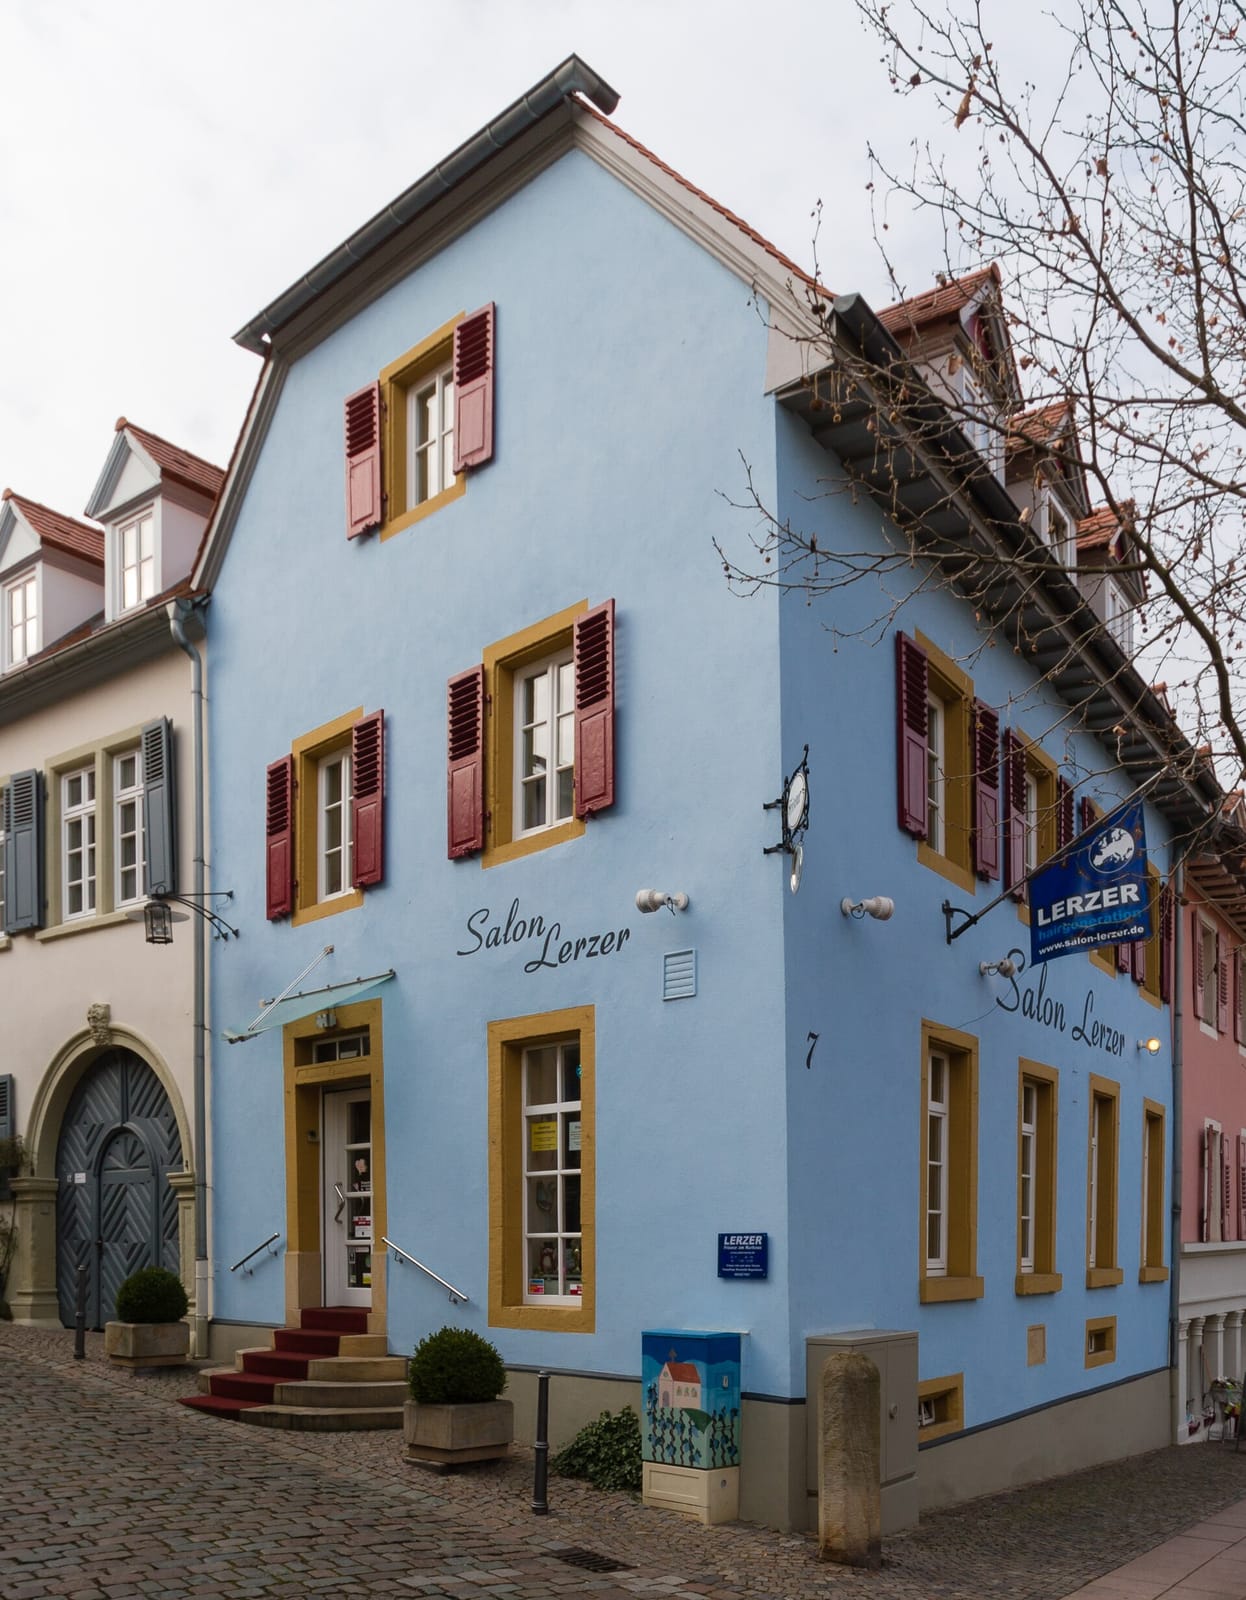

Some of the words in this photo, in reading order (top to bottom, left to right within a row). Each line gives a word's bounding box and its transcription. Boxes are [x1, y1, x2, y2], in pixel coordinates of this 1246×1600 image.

[456, 897, 546, 956] Salon
[1037, 883, 1140, 927] LERZER
[524, 922, 631, 974] Lerzer
[1038, 925, 1145, 956] www.salon-lerzer.de
[995, 948, 1066, 1033] Salon
[1071, 989, 1125, 1057] Lerzer
[806, 1031, 820, 1070] 7
[724, 1236, 763, 1245] LERZER
